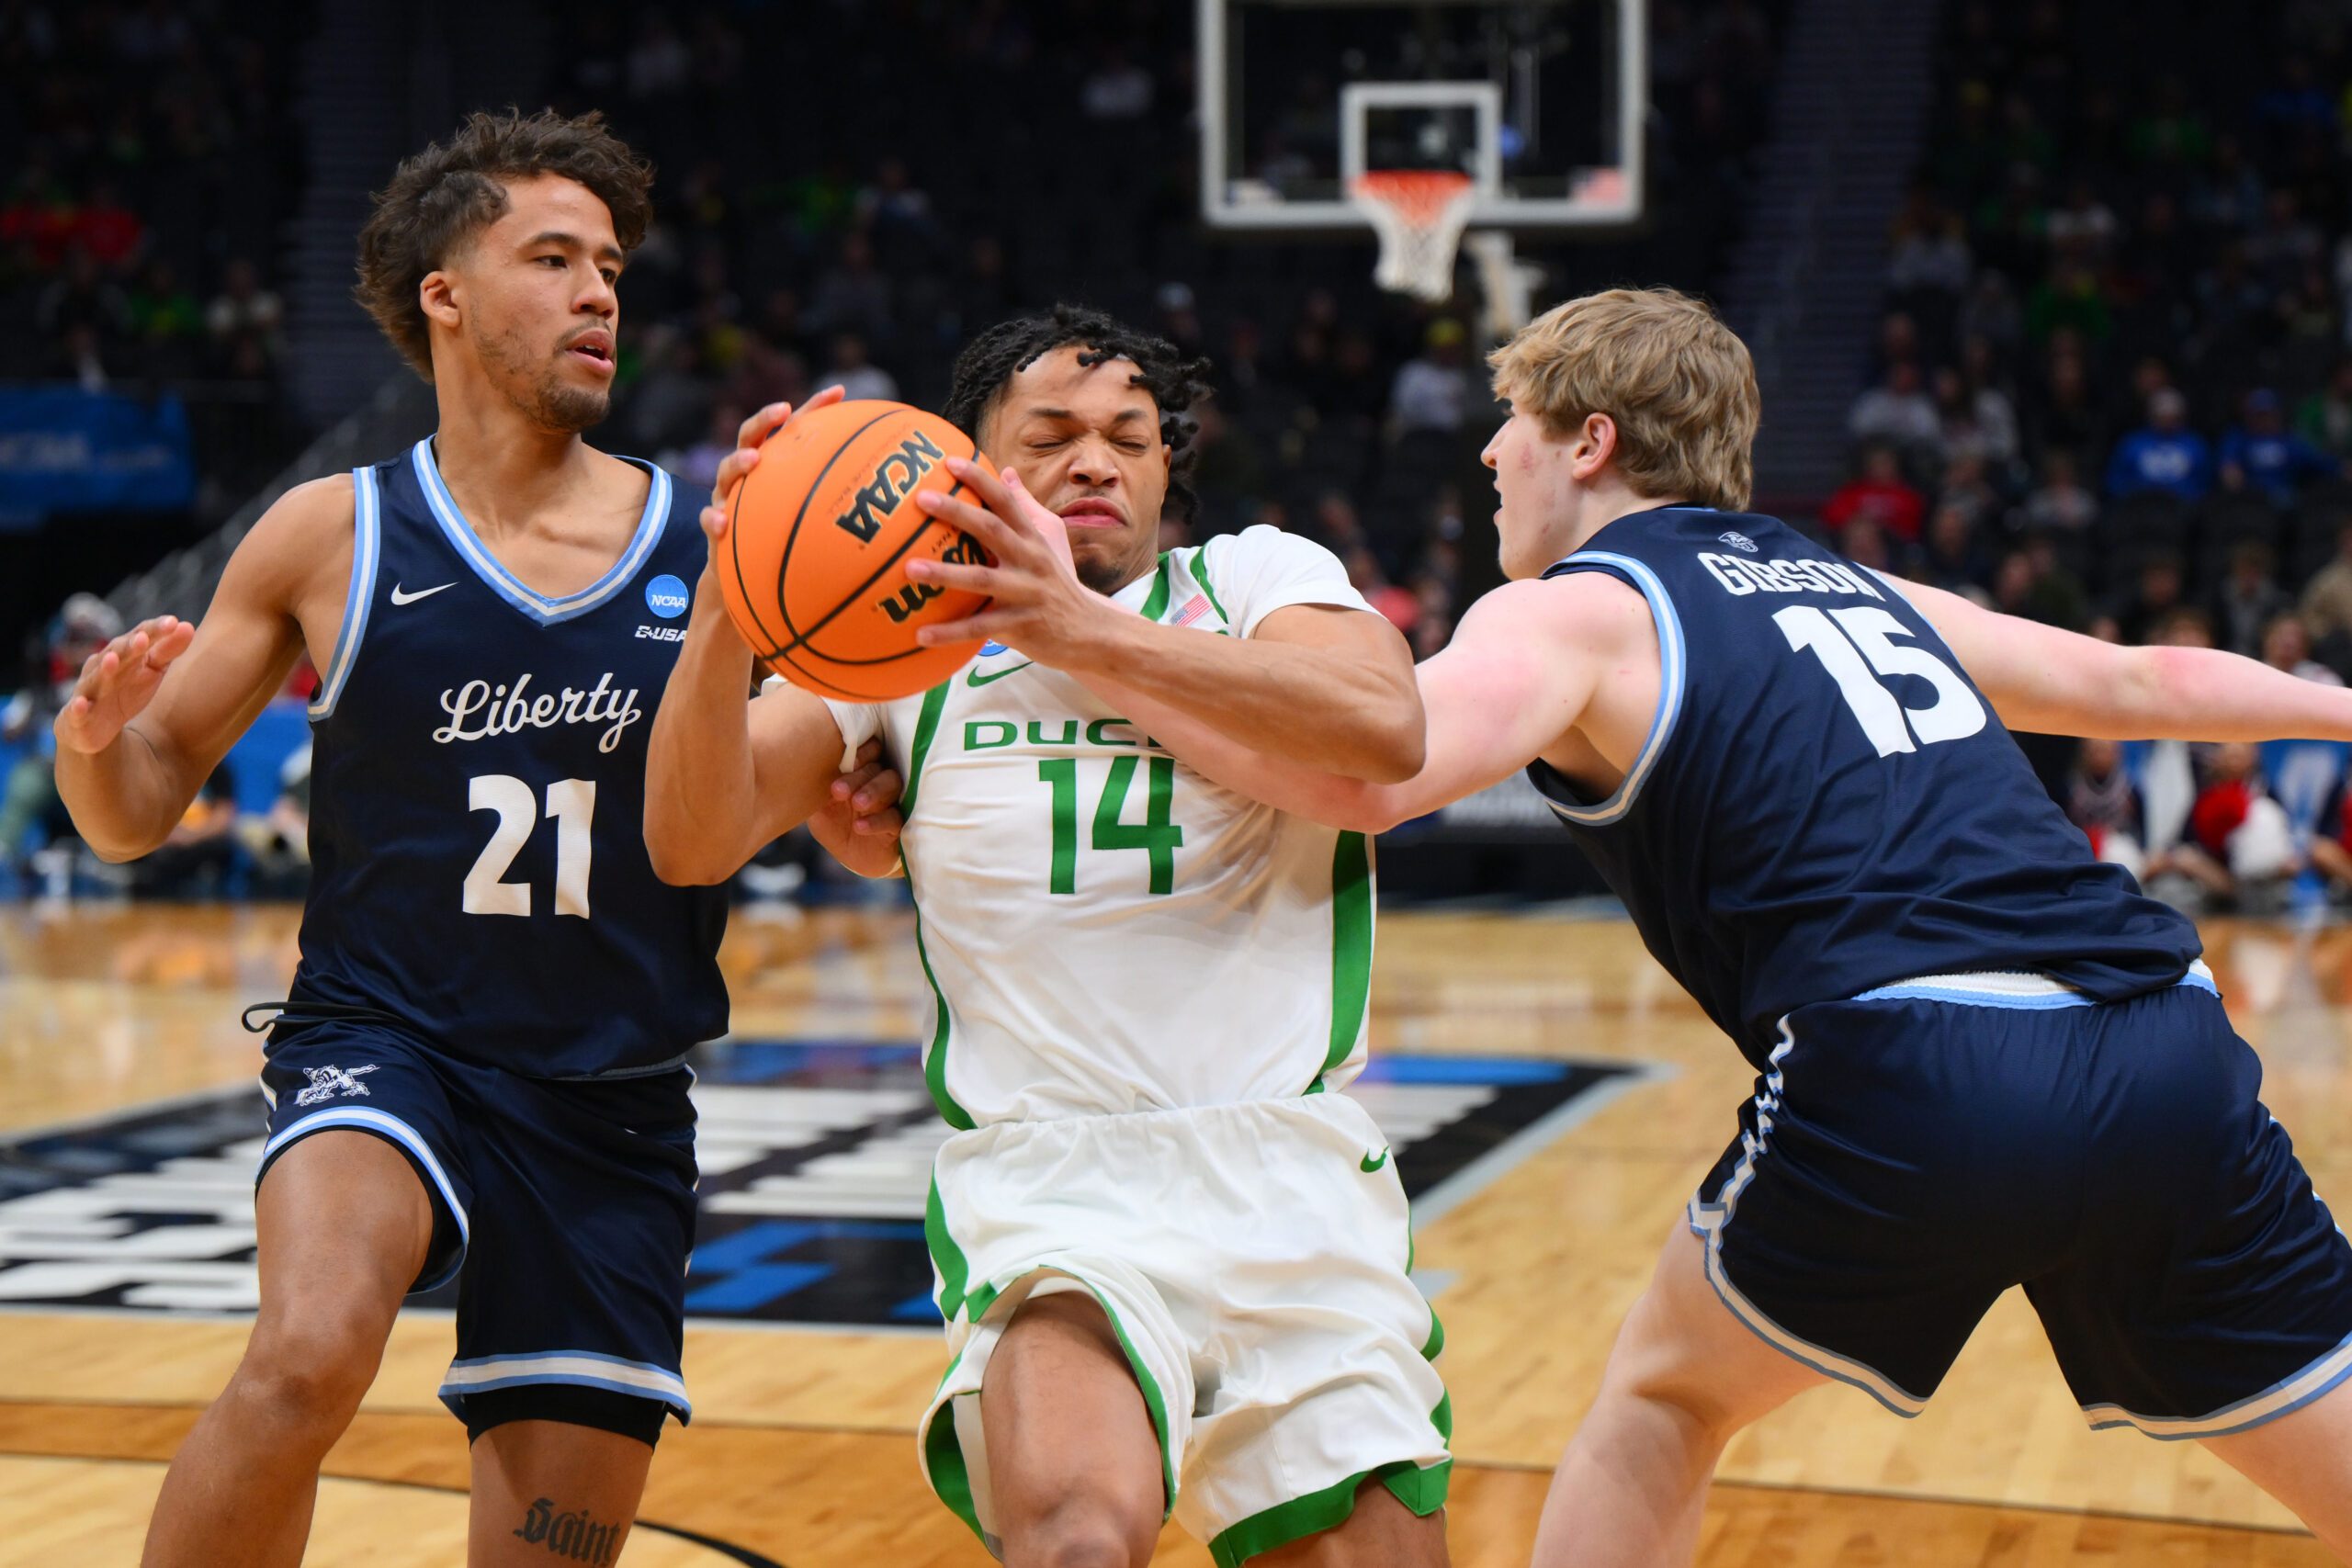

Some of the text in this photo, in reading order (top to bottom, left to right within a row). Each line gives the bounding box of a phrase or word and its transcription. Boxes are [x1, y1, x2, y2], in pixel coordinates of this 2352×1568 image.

[834, 429, 944, 544] NCAA
[650, 594, 687, 608] NCAA
[1697, 552, 1887, 603] GIBSON
[432, 672, 642, 753] Liberty
[1770, 604, 1987, 759] 15
[964, 718, 1163, 751] DUC
[462, 774, 596, 919] 21
[1038, 755, 1183, 895] 14
[513, 1497, 621, 1567] Saint
